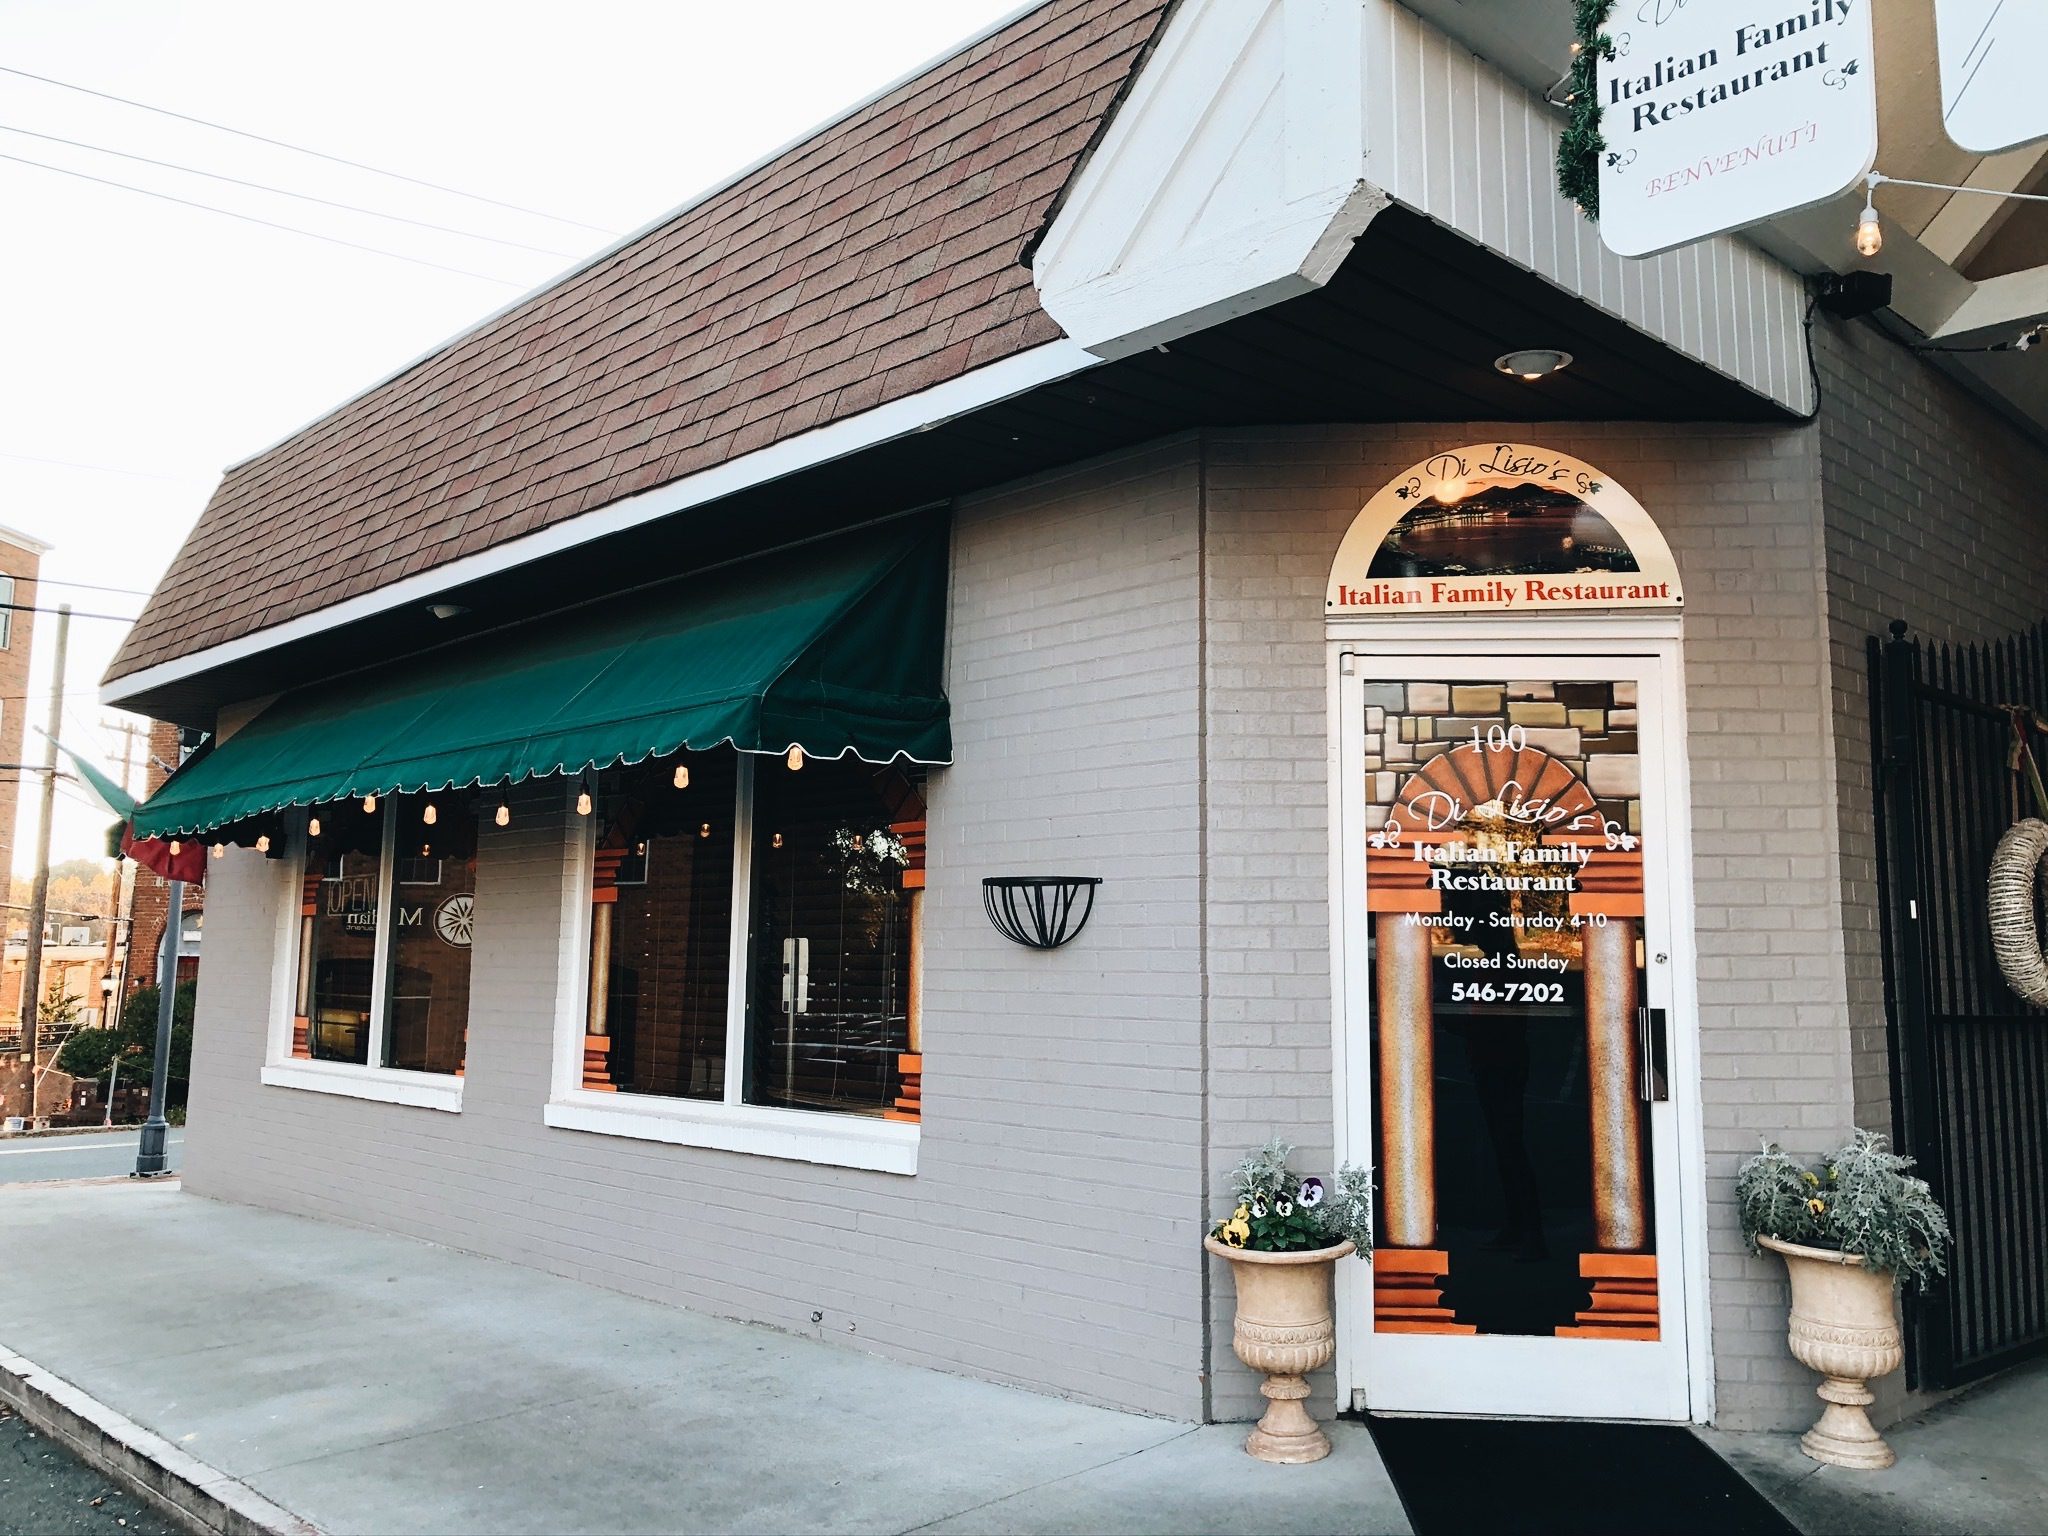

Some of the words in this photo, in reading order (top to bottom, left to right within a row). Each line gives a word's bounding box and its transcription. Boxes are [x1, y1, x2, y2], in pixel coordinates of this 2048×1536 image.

[1609, 47, 1718, 104] Italian
[1735, 0, 1854, 57] Family
[1632, 40, 1831, 133] Restaurant
[1645, 122, 1819, 198] BENVENUTI
[1425, 454, 1471, 481] Di
[1479, 444, 1571, 482] Lisio's
[1337, 584, 1423, 606] Italian
[1431, 582, 1518, 607] Family
[1525, 580, 1671, 601] Restaurant
[1470, 723, 1526, 753] 100
[1407, 790, 1468, 831] Di
[1475, 780, 1597, 831] Lisio's
[1413, 840, 1498, 862] Italian
[1504, 841, 1594, 868] Family
[1431, 868, 1576, 891] Restaurant
[331, 879, 375, 911] OPEN
[1405, 911, 1474, 931] Monday
[1488, 912, 1564, 932] Saturday
[1570, 912, 1607, 928] 4-10
[1444, 952, 1500, 970] Closed
[1506, 953, 1569, 973] Sunday
[1451, 983, 1564, 1002] 546-7202
